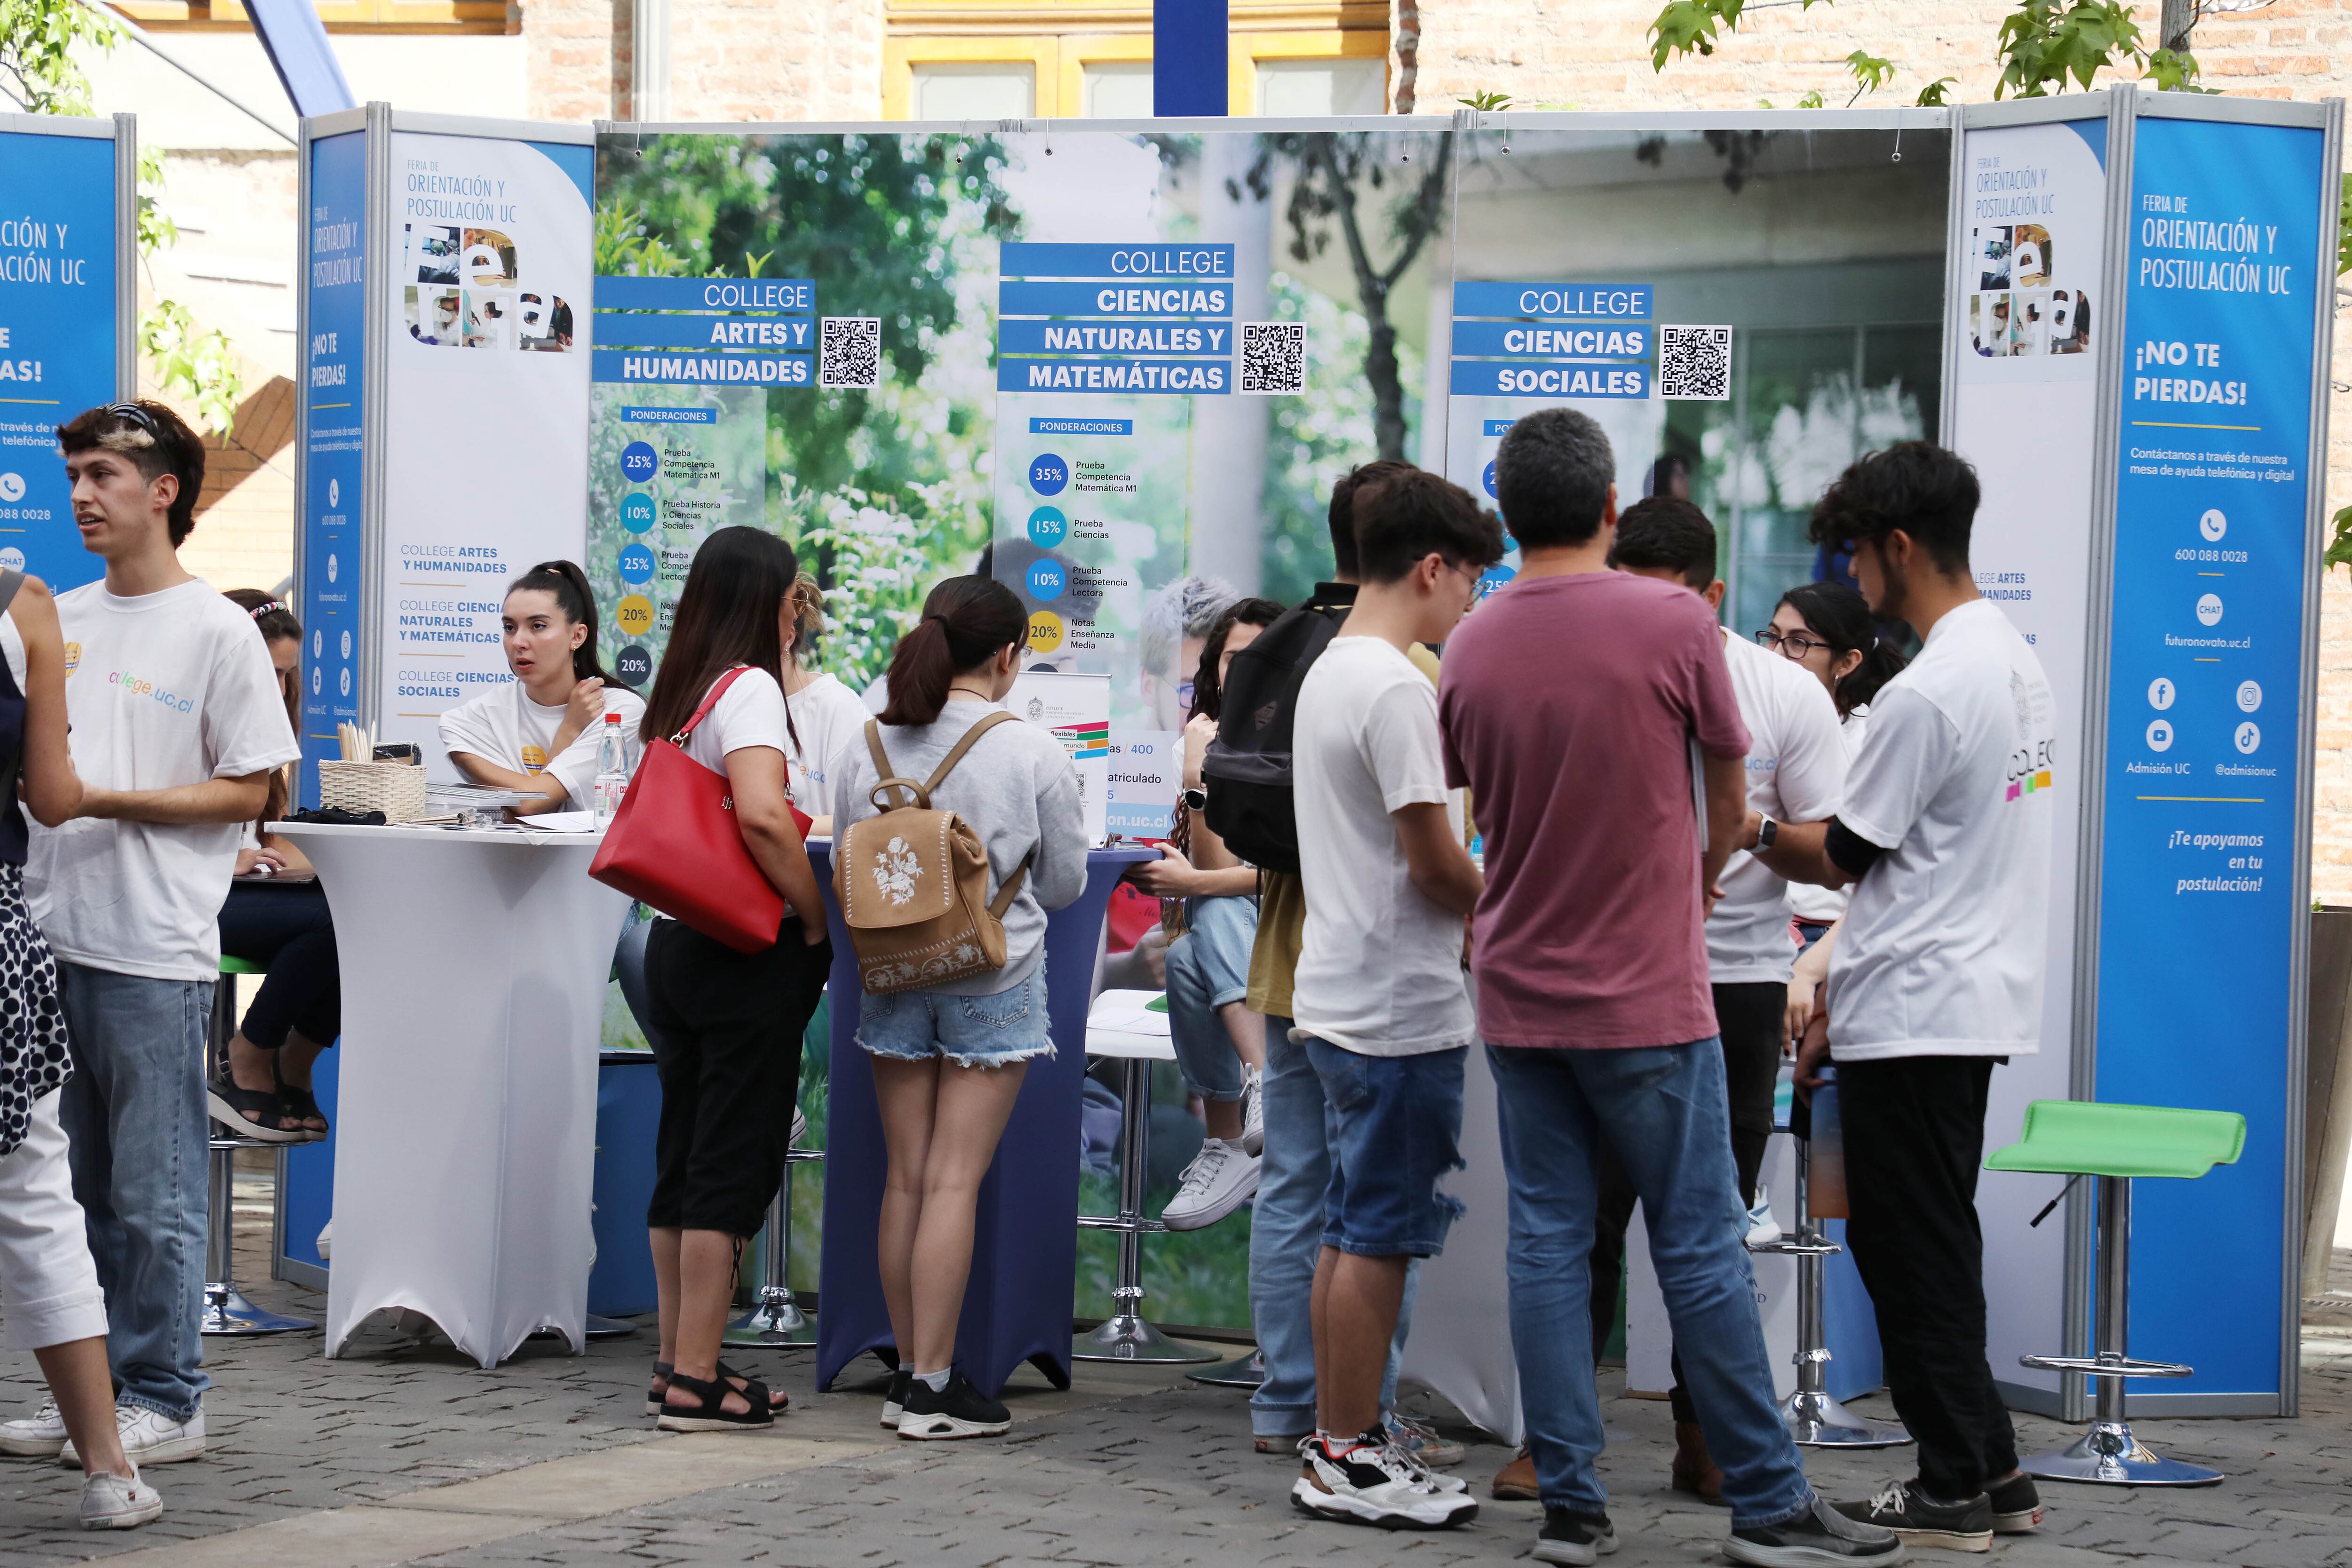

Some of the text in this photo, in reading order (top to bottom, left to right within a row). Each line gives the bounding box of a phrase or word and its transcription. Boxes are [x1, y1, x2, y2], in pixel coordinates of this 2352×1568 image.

[407, 159, 438, 172] FERIA DE
[1977, 157, 2000, 169] FERIA DE
[1977, 166, 2047, 192] ORIENTACIÓN Y
[408, 174, 505, 198] ORIENTACIÓN Y
[408, 198, 516, 223] POSTULACIÓN UC
[1976, 191, 2055, 219] POSTULACIÓN UC
[2143, 195, 2188, 213] FERIA DE
[56, 223, 67, 249] Y
[314, 217, 357, 254] ORIENTACIÓN Y
[2142, 216, 2277, 254] ORIENTACIÓN Y
[1111, 251, 1226, 274] COLLEGE
[61, 259, 85, 285] UC
[314, 252, 362, 288] POSTULACIÓN UC
[2141, 256, 2291, 295] POSTULACIÓN UC
[704, 285, 808, 307] COLLEGE
[1097, 289, 1225, 313] CIENCIAS
[1520, 290, 1645, 315] COLLEGE
[710, 322, 808, 345] ARTES Y
[1044, 327, 1224, 351] NATURALES Y
[313, 333, 336, 362] ¡NO TE
[1504, 330, 1643, 355] CIENCIAS
[2136, 341, 2220, 371] ¡NO TE
[312, 364, 346, 387] PIERDAS!
[624, 357, 807, 382] HUMANIDADES
[1028, 361, 1223, 389] MATEMÁTICAS
[1498, 369, 1642, 395] SOCIALES
[2135, 377, 2247, 406] PIERDAS!
[631, 410, 707, 421] PONDERACIONES
[0, 422, 33, 432] través
[36, 422, 49, 433] de
[1040, 422, 1122, 432] PONDERACIONES
[3, 435, 56, 447] telefónica
[627, 456, 652, 468] 25%
[2130, 447, 2196, 461] Contáctanos
[2206, 452, 2236, 463] través
[2238, 452, 2250, 463] de
[2252, 454, 2288, 465] nuestra
[664, 460, 715, 469] Competencia
[664, 470, 707, 479] Matemática
[1036, 468, 1062, 481] 35%
[1076, 472, 1130, 481] Competencia
[2130, 464, 2295, 482] mesa de ayuda telefónica y digital
[1075, 484, 1123, 492] Matemática
[22, 509, 51, 520] 0028
[628, 507, 650, 519] 10%
[1036, 521, 1060, 533] 15%
[1074, 530, 1109, 539] Ciencias
[401, 545, 497, 558] COLLEGE ARTES
[2175, 549, 2248, 563] 600 088 0028
[403, 560, 507, 573] Y HUMANIDADES
[624, 557, 649, 570] 25%
[661, 562, 692, 570] Compet
[1034, 573, 1058, 586] 10%
[1073, 578, 1127, 587] Competencia
[1975, 573, 2025, 583] LEGE ARTES
[1979, 589, 2031, 600] MANIDADES
[400, 600, 504, 613] COLLEGE CIENCI
[2199, 605, 2220, 614] CHAT
[624, 609, 647, 621] 20%
[400, 616, 473, 628] NATURALES
[399, 630, 500, 643] Y MATEMÁTICAS
[1031, 626, 1057, 638] 20%
[2165, 633, 2251, 648] futuronovato.uc.cl
[621, 660, 646, 672] 20%
[398, 670, 515, 683] COLLEGE CIENCIAS
[398, 686, 460, 697] SOCIALES
[1131, 745, 1153, 754] 400
[2126, 761, 2191, 775] Admisión UC
[2215, 764, 2277, 777] @admisionuc
[1108, 773, 1161, 783] atriculado
[2169, 830, 2264, 850] ¡Te apoyamos
[2228, 856, 2263, 869] en tu
[2176, 876, 2264, 895] postulación!
